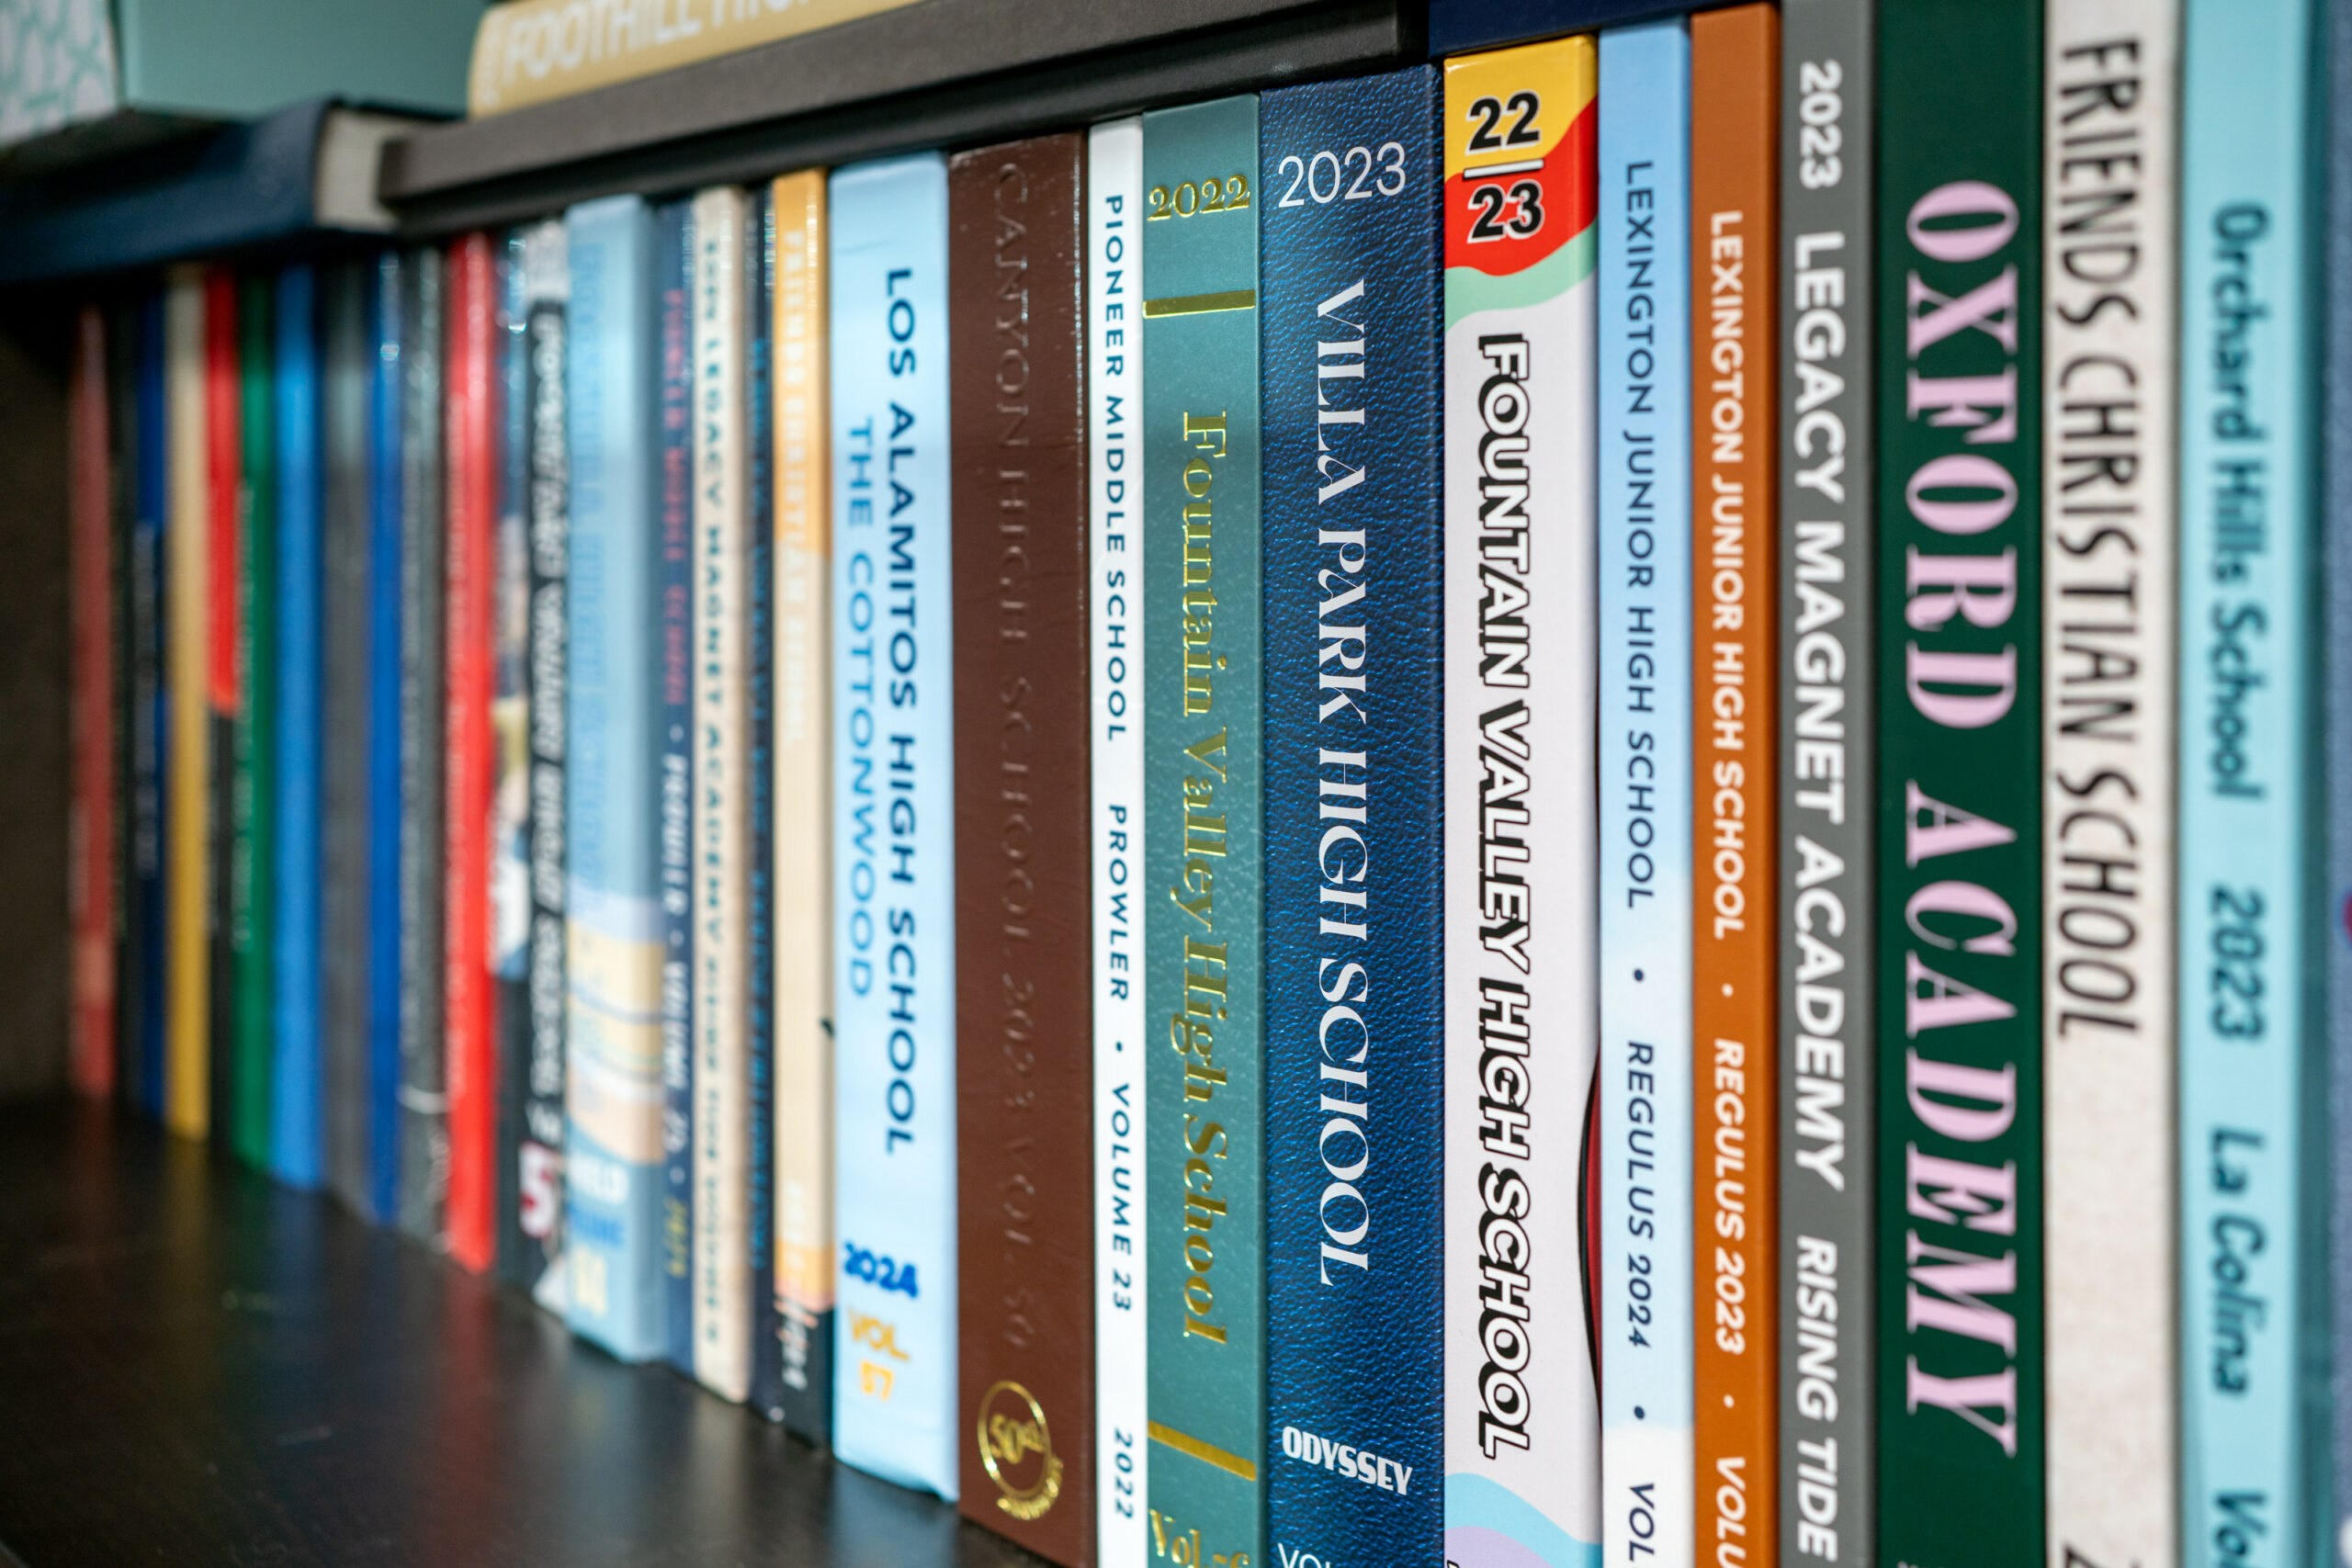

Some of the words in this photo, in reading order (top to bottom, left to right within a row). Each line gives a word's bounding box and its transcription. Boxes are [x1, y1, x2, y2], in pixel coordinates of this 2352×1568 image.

[1148, 174, 1250, 220] 2022
[1278, 141, 1406, 208] 2023
[1465, 89, 1542, 156] 22
[1467, 179, 1544, 244] 23
[1799, 60, 1842, 189] 2023
[2056, 39, 2142, 328] FRIENDS
[887, 268, 917, 378] LOS
[1103, 195, 1125, 378] PIONEER
[1625, 162, 1656, 415] LEXINGTON
[1710, 210, 1744, 463] LEXINGTON
[1793, 231, 1846, 502] LEGACY
[2210, 200, 2273, 443] Orchard
[848, 416, 875, 527] THE
[1105, 394, 1126, 553] MIDDLE
[1317, 278, 1365, 506] VILLA
[1905, 180, 2020, 729] OXFORD
[888, 400, 918, 709] ALAMITOS
[1181, 410, 1228, 717] Fountain
[1477, 333, 1531, 689] FOUNTAIN
[1623, 428, 1655, 590] JUNIOR
[1710, 474, 1744, 631] JUNIOR
[2056, 355, 2141, 741] CHRISTIAN
[2212, 460, 2271, 585] Hills
[1106, 570, 1127, 742] SCHOOL
[1317, 528, 1367, 726] PARK
[1626, 606, 1656, 714] HIGH
[1712, 641, 1745, 751] HIGH
[1793, 522, 1846, 823] MAGNET
[2211, 601, 2271, 802] School
[848, 551, 876, 998] COTTONWOOD
[888, 733, 917, 885] HIGH
[1170, 726, 1228, 932] Valley
[1318, 748, 1369, 939] HIGH
[1477, 701, 1531, 975] VALLEY
[1626, 730, 1656, 909] SCHOOL
[1713, 761, 1746, 940] SCHOOL
[1108, 805, 1130, 1002] PROWLER
[2056, 770, 2141, 1043] SCHOOL
[2208, 884, 2268, 1043] 2023
[888, 909, 917, 1155] SCHOOL
[1170, 935, 1227, 1104] High
[1477, 977, 1531, 1160] HIGH
[1793, 836, 1845, 1192] ACADEMY
[1112, 1083, 1132, 1253] VOLUME
[1318, 957, 1370, 1288] SCHOOL
[1627, 1042, 1655, 1239] REGULUS
[1713, 1037, 1746, 1241] REGULUS
[1905, 779, 2018, 1459] ACADEMY
[2211, 1125, 2267, 1196] La
[843, 1240, 919, 1300] 2024
[1113, 1269, 1133, 1312] 23
[1182, 1113, 1228, 1346] School
[1477, 1162, 1531, 1461] SCHOOL
[1626, 1252, 1654, 1349] 2024
[1713, 1246, 1746, 1355] 2023
[2211, 1213, 2269, 1396] Colina
[847, 1305, 910, 1363] VOL
[1796, 1235, 1838, 1423] RISING
[1115, 1427, 1135, 1520] 2022
[1282, 1426, 1413, 1495] ODYSSEY
[1796, 1437, 1838, 1562] TIDE
